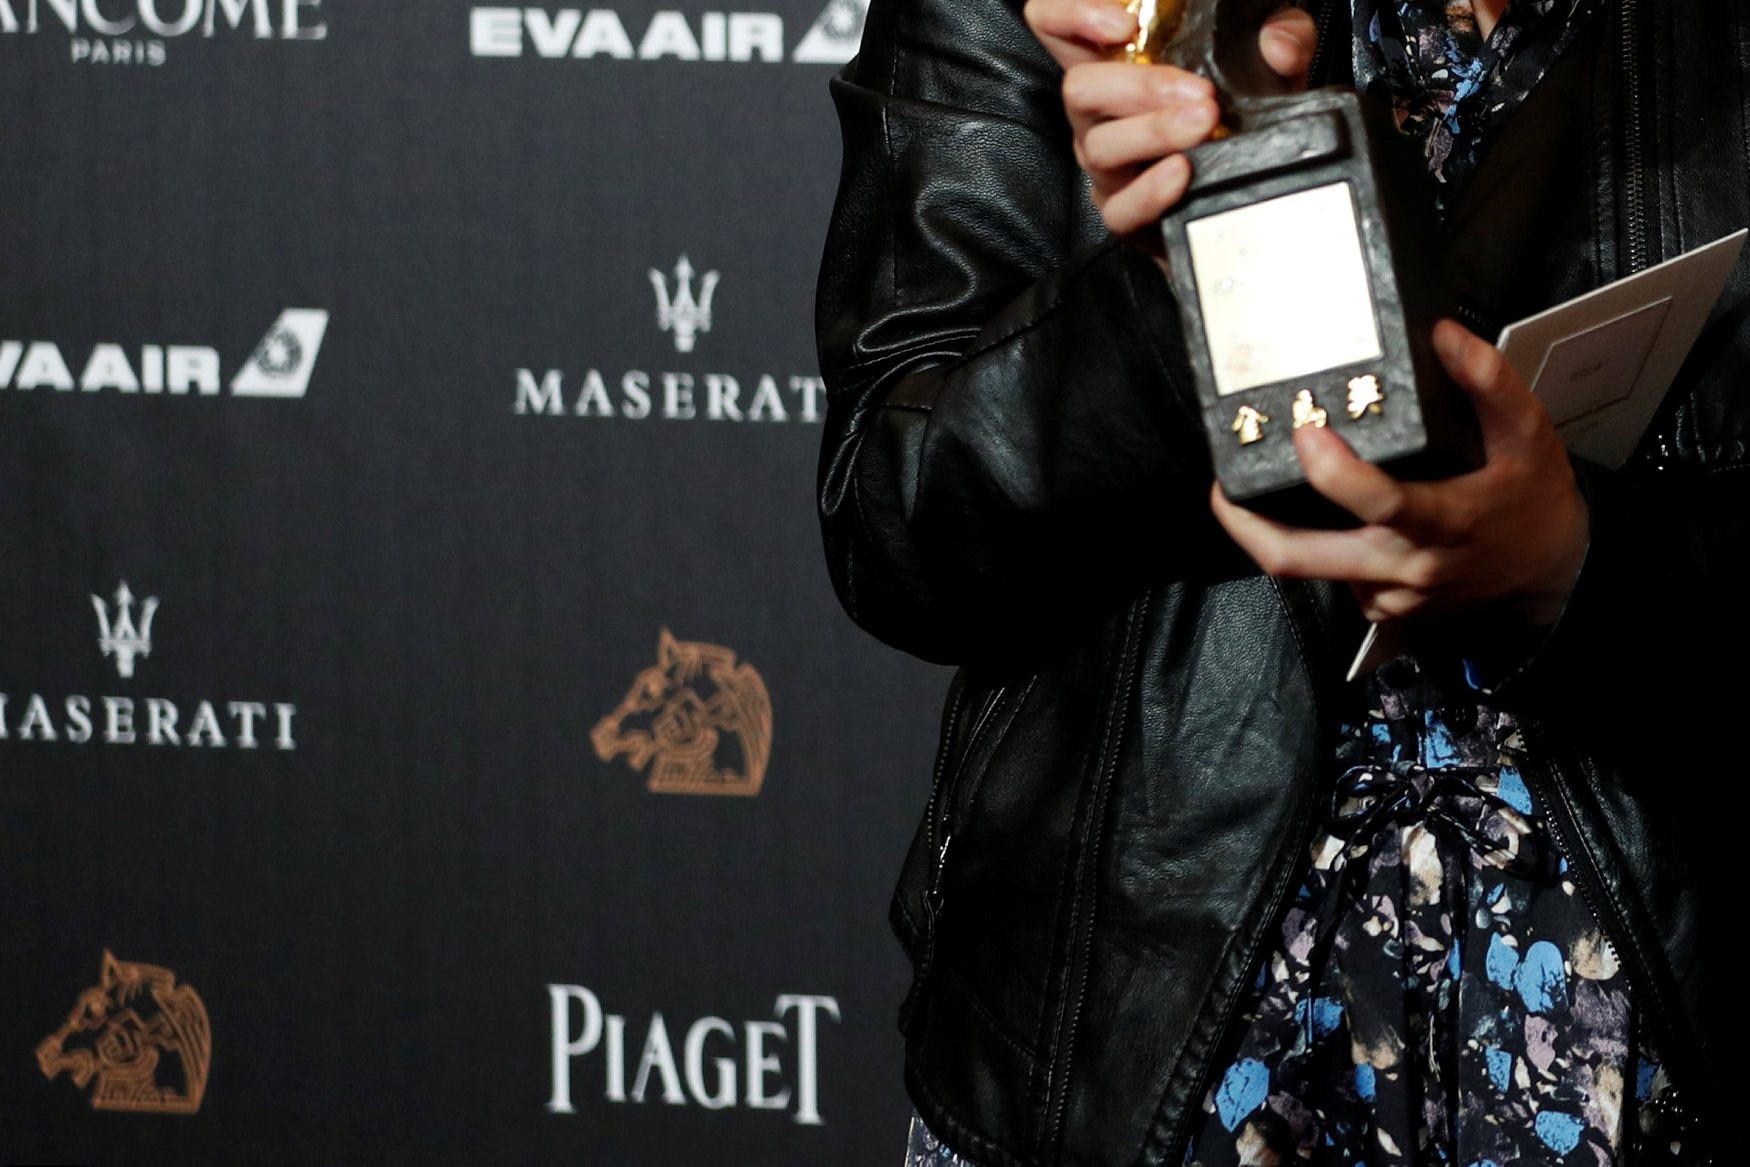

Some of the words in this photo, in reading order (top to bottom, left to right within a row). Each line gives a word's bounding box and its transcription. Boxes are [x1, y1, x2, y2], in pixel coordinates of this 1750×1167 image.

[70, 39, 167, 67] PARIS
[514, 367, 826, 424] MASERAT
[0, 691, 297, 751] ASERATI
[547, 982, 841, 1125] PIAGET
